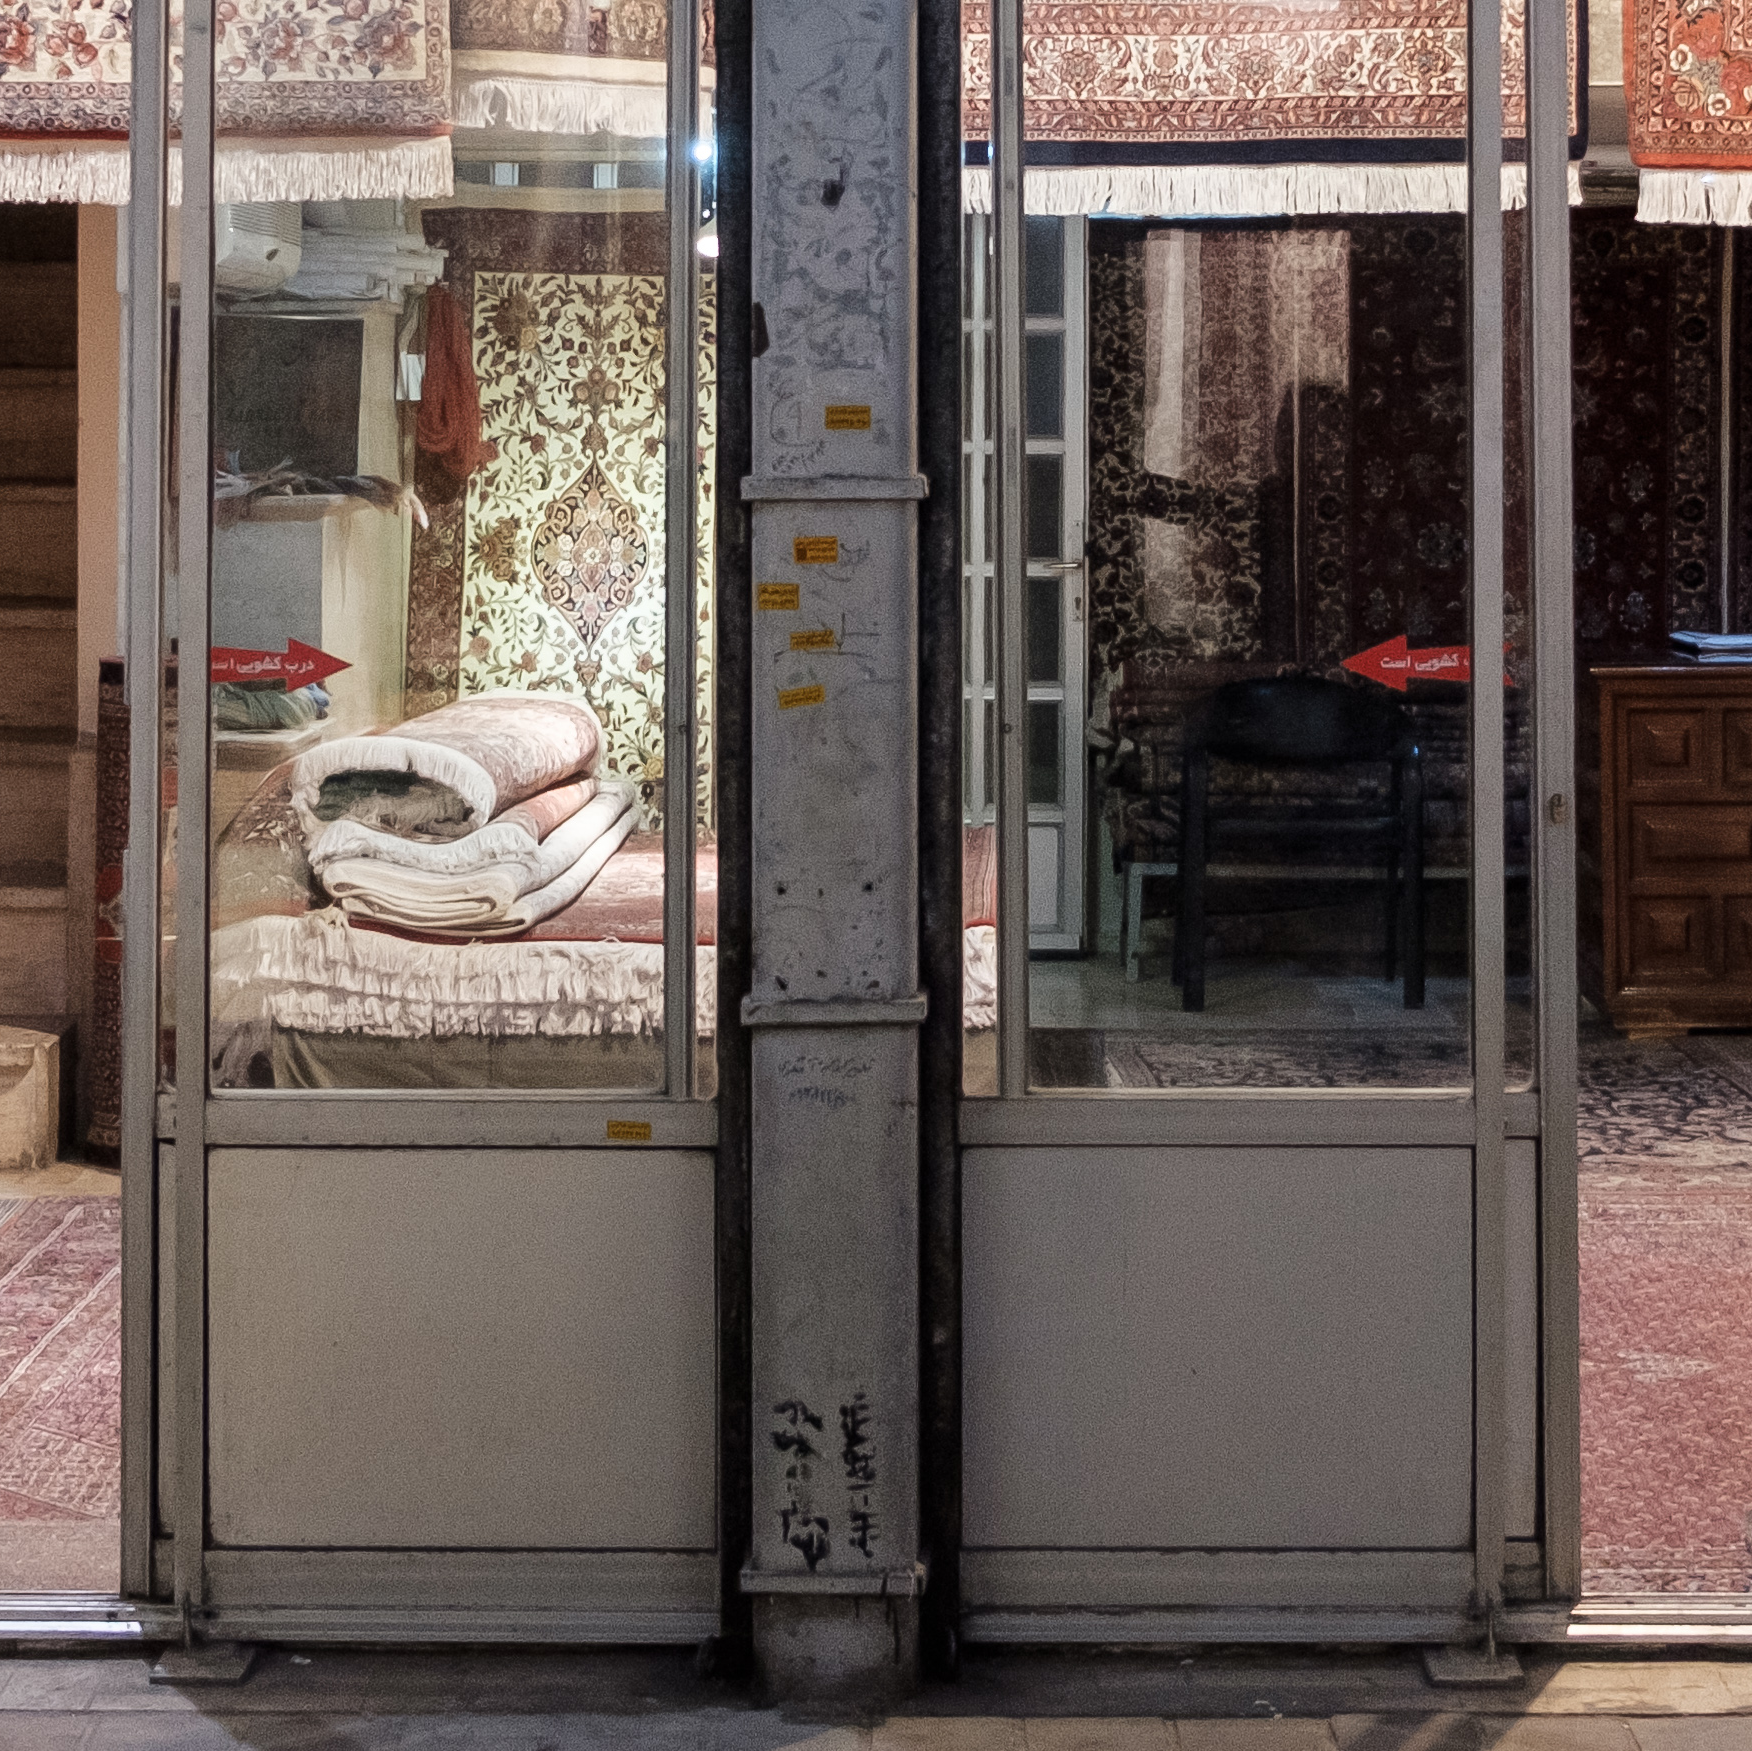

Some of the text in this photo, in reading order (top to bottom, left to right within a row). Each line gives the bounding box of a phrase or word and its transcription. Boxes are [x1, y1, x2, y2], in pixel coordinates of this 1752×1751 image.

[212, 655, 314, 674] درب کشویی اس
[1381, 655, 1411, 668] است
[1415, 653, 1459, 671] کشویی
